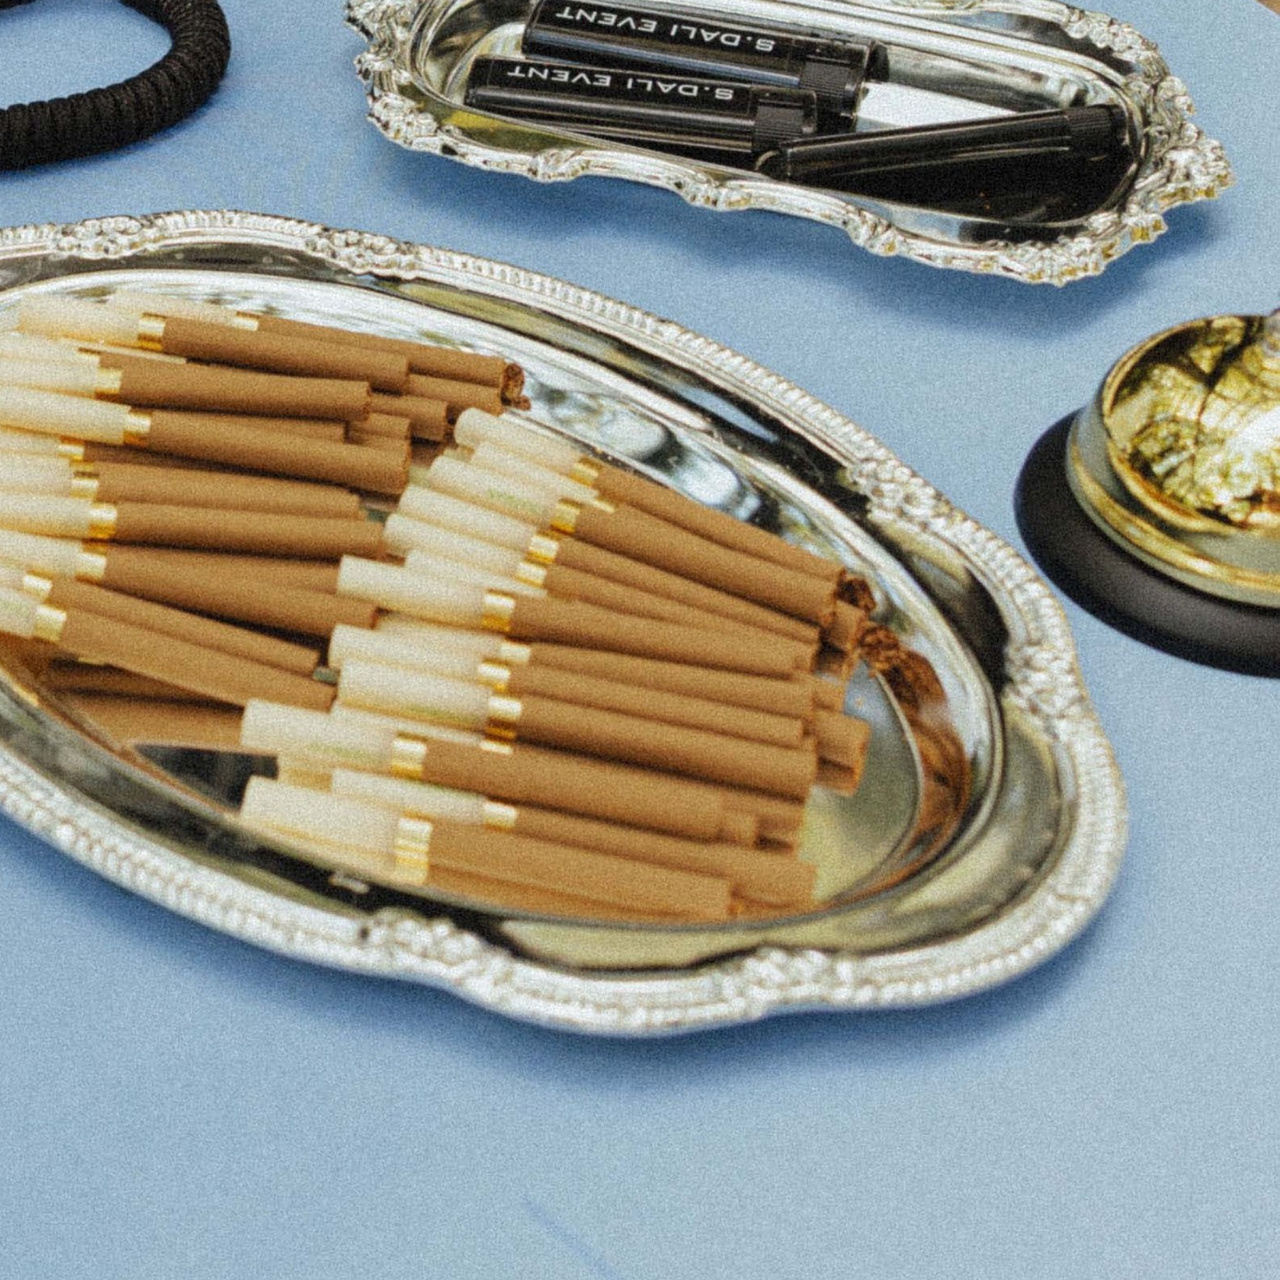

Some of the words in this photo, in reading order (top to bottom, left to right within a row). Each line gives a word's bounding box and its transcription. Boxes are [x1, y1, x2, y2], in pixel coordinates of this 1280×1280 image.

[556, 5, 658, 33] EVENT
[670, 23, 776, 52] S.DALI
[507, 65, 612, 87] EVENT
[626, 76, 735, 100] S.DALI
